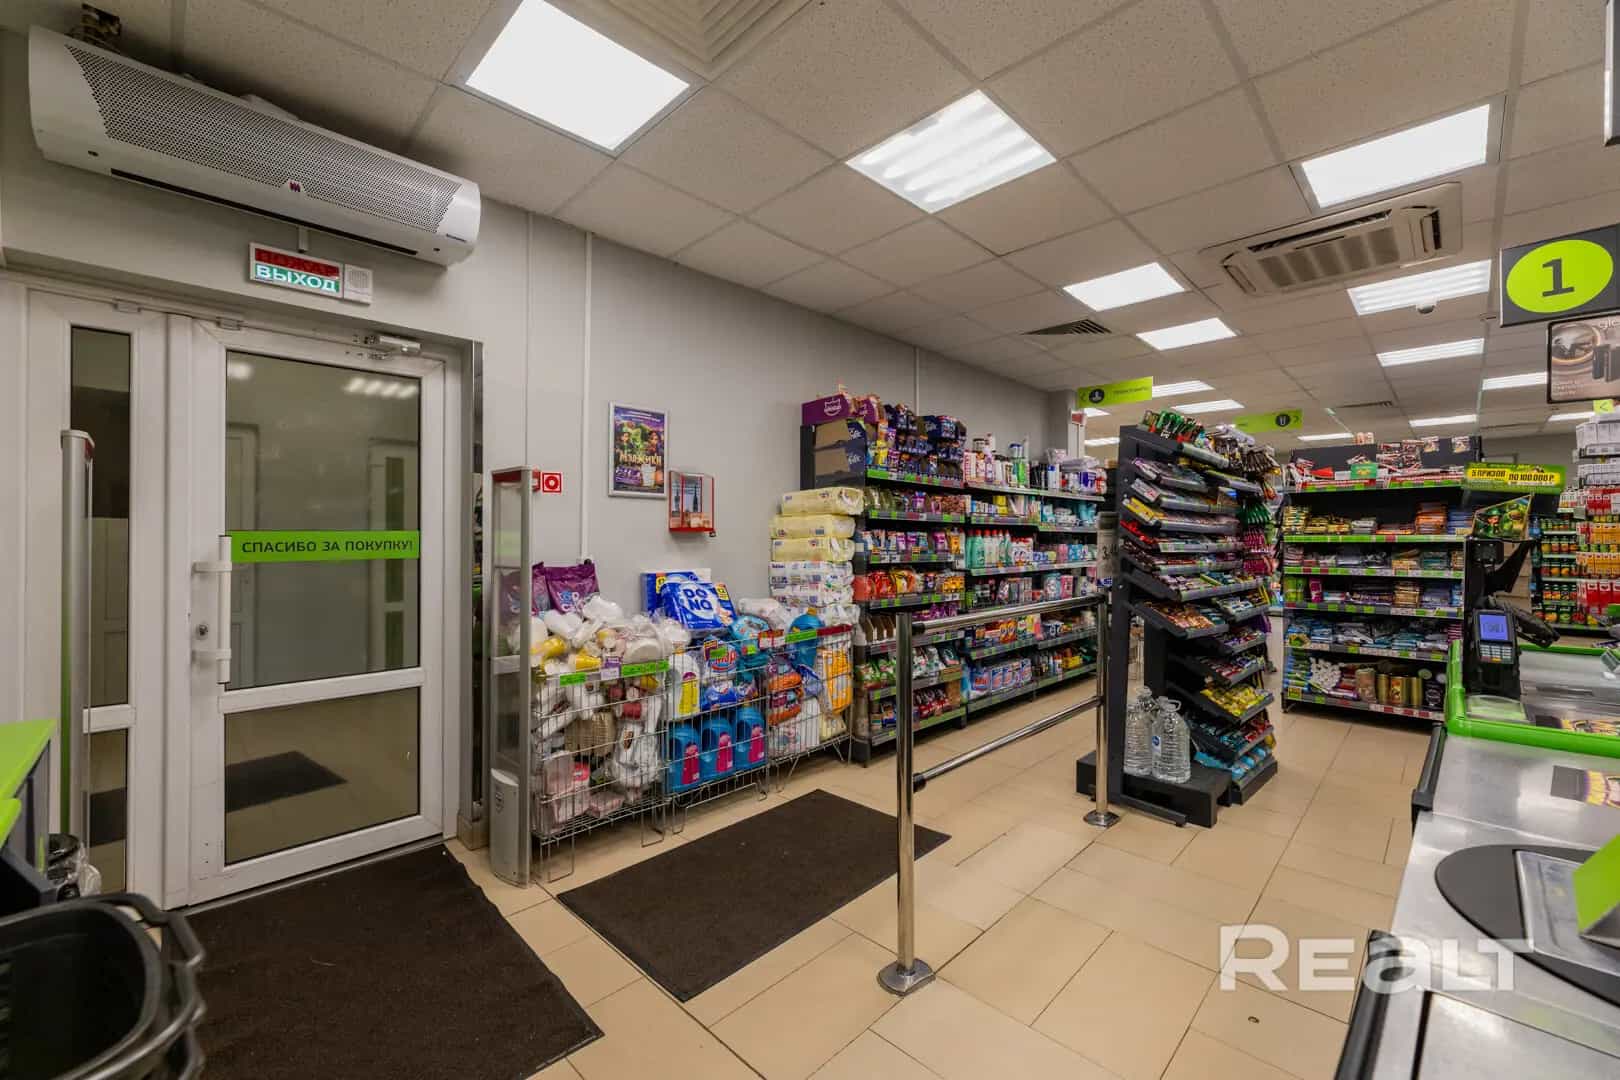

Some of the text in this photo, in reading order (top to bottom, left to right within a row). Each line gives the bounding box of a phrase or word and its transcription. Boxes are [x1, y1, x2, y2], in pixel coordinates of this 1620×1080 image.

[256, 264, 336, 292] ВЫХОД
[1542, 258, 1574, 297] 1
[1521, 473, 1532, 481] 100
[242, 540, 413, 553] СПАСИБО ЗА ПОКУПКУ!
